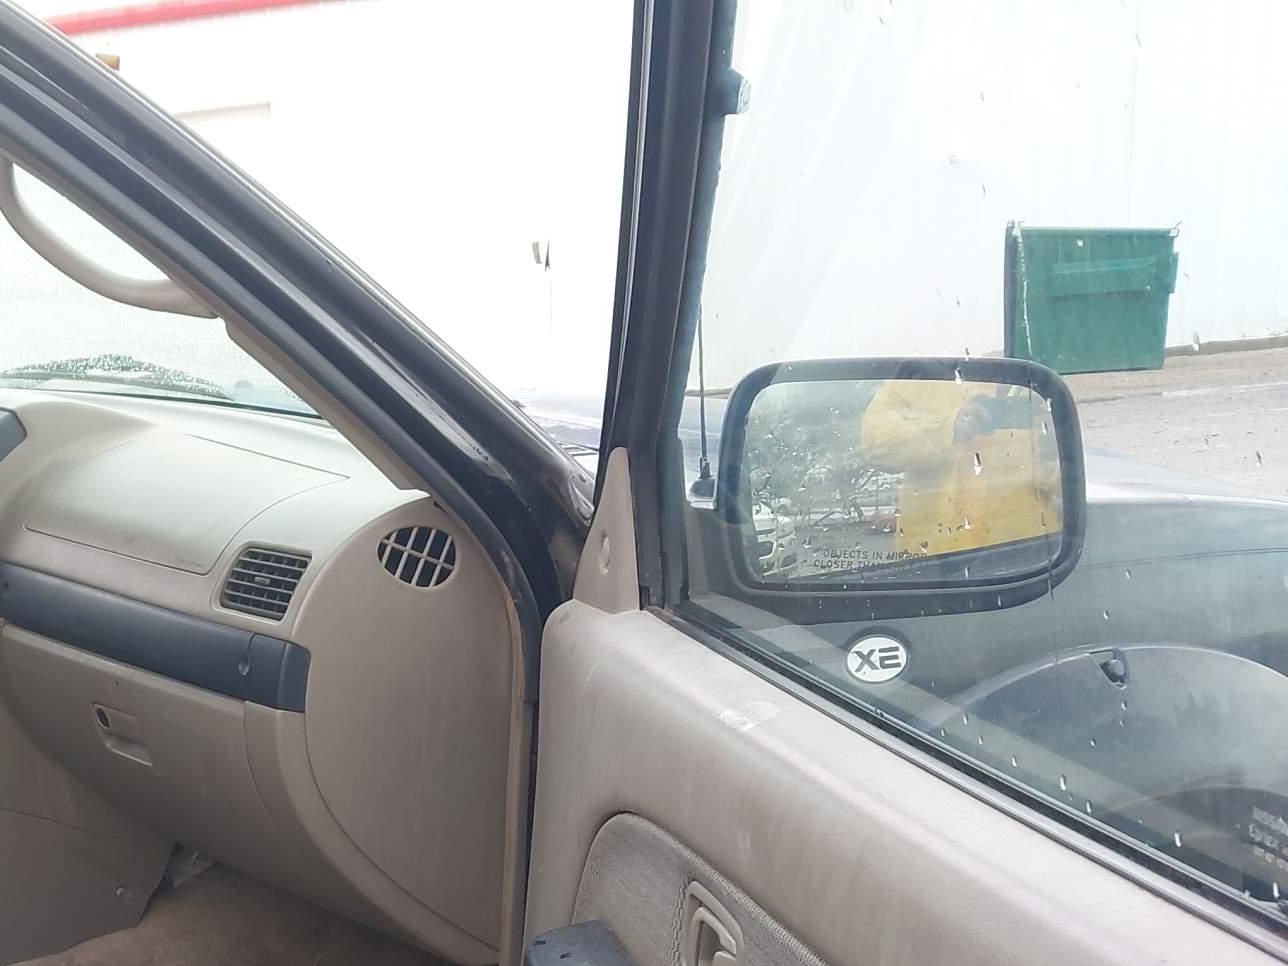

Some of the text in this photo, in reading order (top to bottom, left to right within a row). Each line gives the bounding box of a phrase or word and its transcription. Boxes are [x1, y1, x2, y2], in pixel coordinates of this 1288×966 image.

[823, 549, 869, 559] OBJECTS
[872, 551, 883, 560] IN
[813, 560, 853, 569] CLOSER
[852, 646, 901, 673] XE
